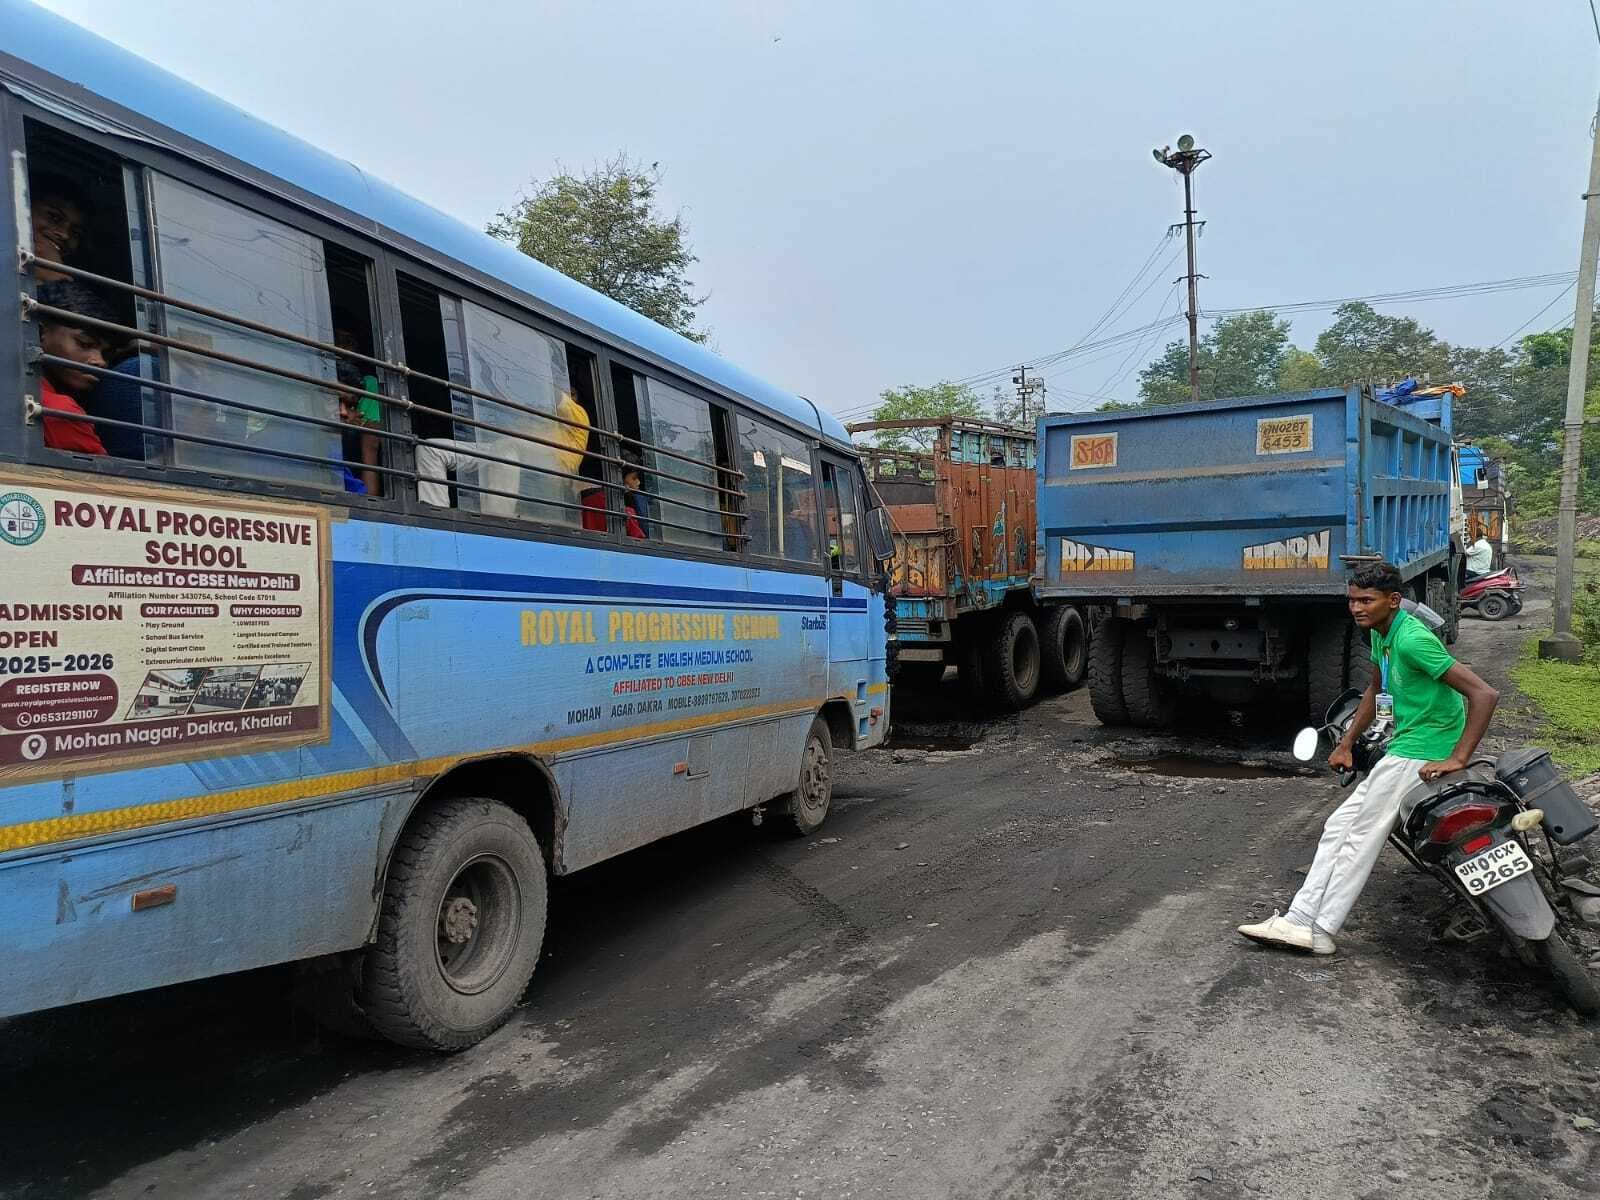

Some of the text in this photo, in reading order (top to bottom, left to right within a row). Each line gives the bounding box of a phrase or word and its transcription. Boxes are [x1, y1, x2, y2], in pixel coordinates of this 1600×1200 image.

[54, 500, 311, 545] ROYAL PROGRESSIVE
[145, 540, 247, 568] SCHOOL
[82, 568, 294, 590] Affiliated To CBSE New Delhi
[108, 591, 147, 600] Affiliation
[150, 592, 178, 600] Number
[0, 604, 123, 621] ADMISSION
[146, 606, 215, 615] OUR FACILITIES
[233, 607, 253, 615] WHY
[254, 607, 285, 615] CHOOSE
[145, 622, 160, 630] Play
[520, 610, 780, 647] ROYAL PROGRESSIVE SCHOOL
[801, 615, 826, 630] Starbus
[0, 631, 58, 649] OPEN
[145, 646, 167, 654] Digital
[585, 657, 594, 674] A
[597, 653, 651, 673] COMPLETE
[658, 651, 693, 669] ENGLISH
[694, 650, 724, 666] MEDIUM
[16, 681, 101, 695] REGISTER NOW
[613, 671, 735, 695] AFFILIATED TO CBSE NEW DELHI
[33, 709, 99, 723] 06531291107
[567, 706, 601, 725] MOHAN
[637, 700, 663, 714] DAKRA
[55, 712, 292, 752] Mohan Nagar, Dakra, Khalari
[1469, 857, 1529, 892] 9265
